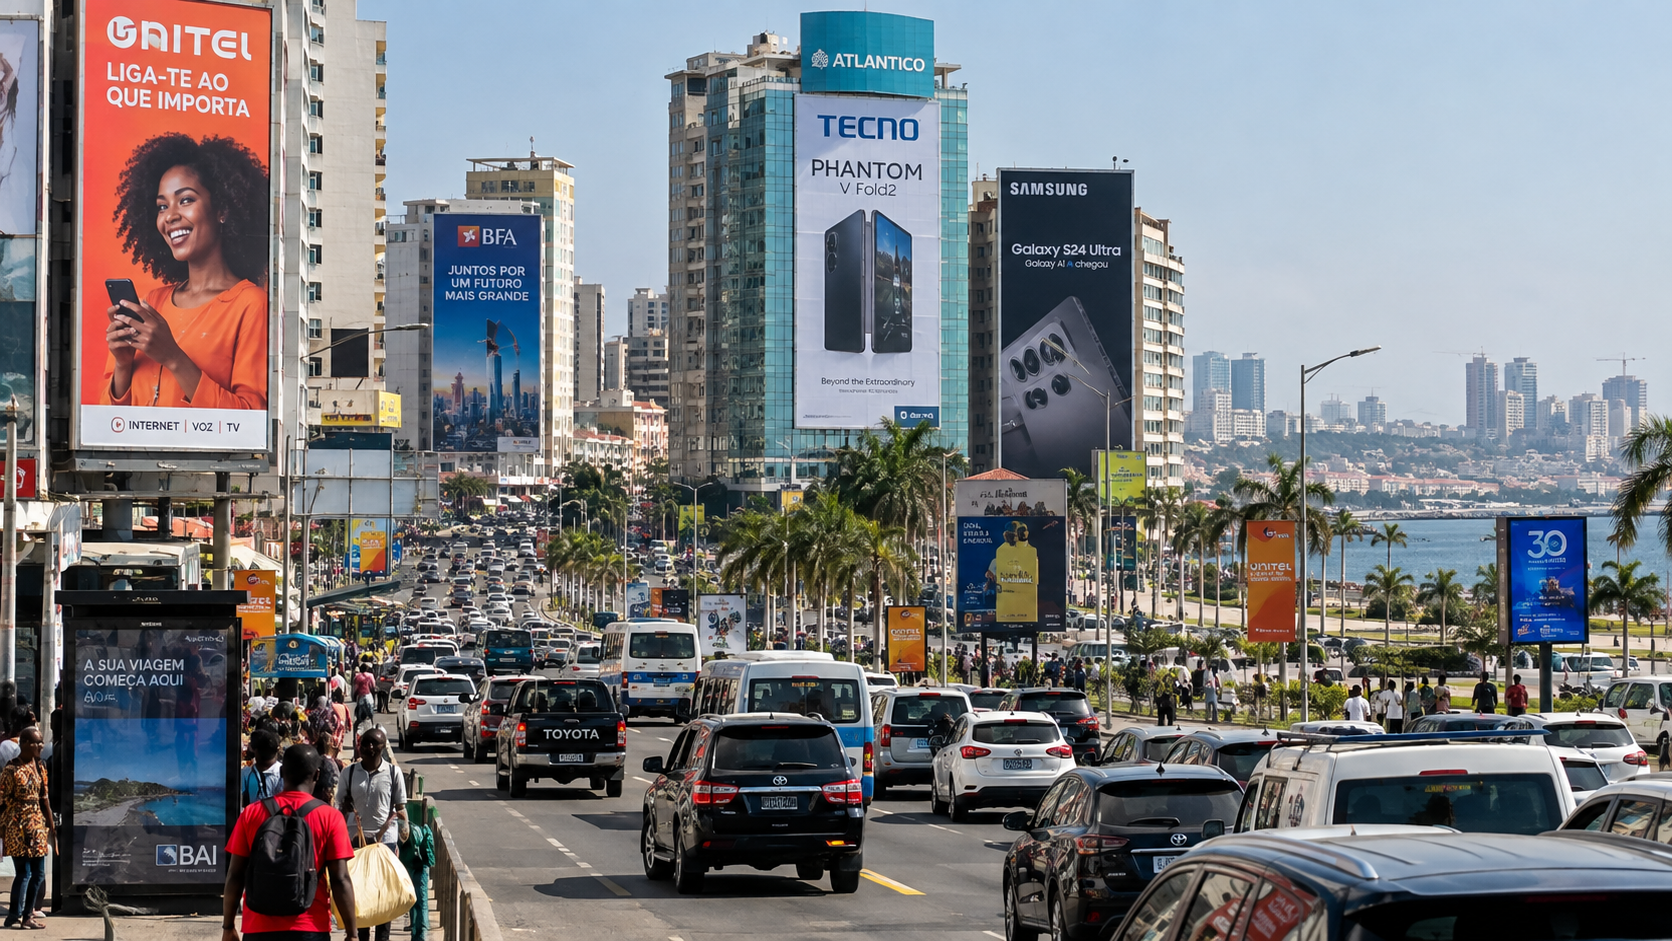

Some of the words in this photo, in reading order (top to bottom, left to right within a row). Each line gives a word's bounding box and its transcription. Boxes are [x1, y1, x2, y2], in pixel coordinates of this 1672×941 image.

[832, 53, 926, 72] ATLANTICO
[107, 61, 192, 88] LIGA-TE
[198, 72, 229, 92] AO
[106, 86, 152, 108] QUE
[158, 91, 250, 118] IMPORTA
[817, 114, 919, 141] TECNO
[811, 159, 922, 181] PHANTOM
[840, 182, 851, 195] V
[856, 183, 897, 197] Fold2
[1010, 182, 1088, 196] SAMSUNG
[482, 228, 518, 246] BFA
[1011, 243, 1060, 258] Galaxy
[1063, 244, 1087, 256] S24
[1089, 244, 1121, 256] Ultra
[448, 265, 497, 276] JUNTOS
[500, 266, 526, 277] POR
[1074, 260, 1109, 270] chegou
[451, 278, 471, 289] UM
[445, 290, 475, 301] MAIS
[478, 291, 530, 302] GRANDE
[821, 377, 850, 387] Beyond
[851, 377, 864, 386] the
[128, 420, 180, 431] INTERNET
[192, 422, 214, 433] VOZ
[226, 423, 241, 433] TV
[1527, 529, 1568, 559] 30
[84, 659, 95, 671] A
[98, 658, 126, 671] SUA
[129, 658, 185, 671] VIAGEM
[83, 674, 147, 690] COMEÇA
[543, 728, 600, 740] TOYOTA
[179, 845, 217, 866] BAI
